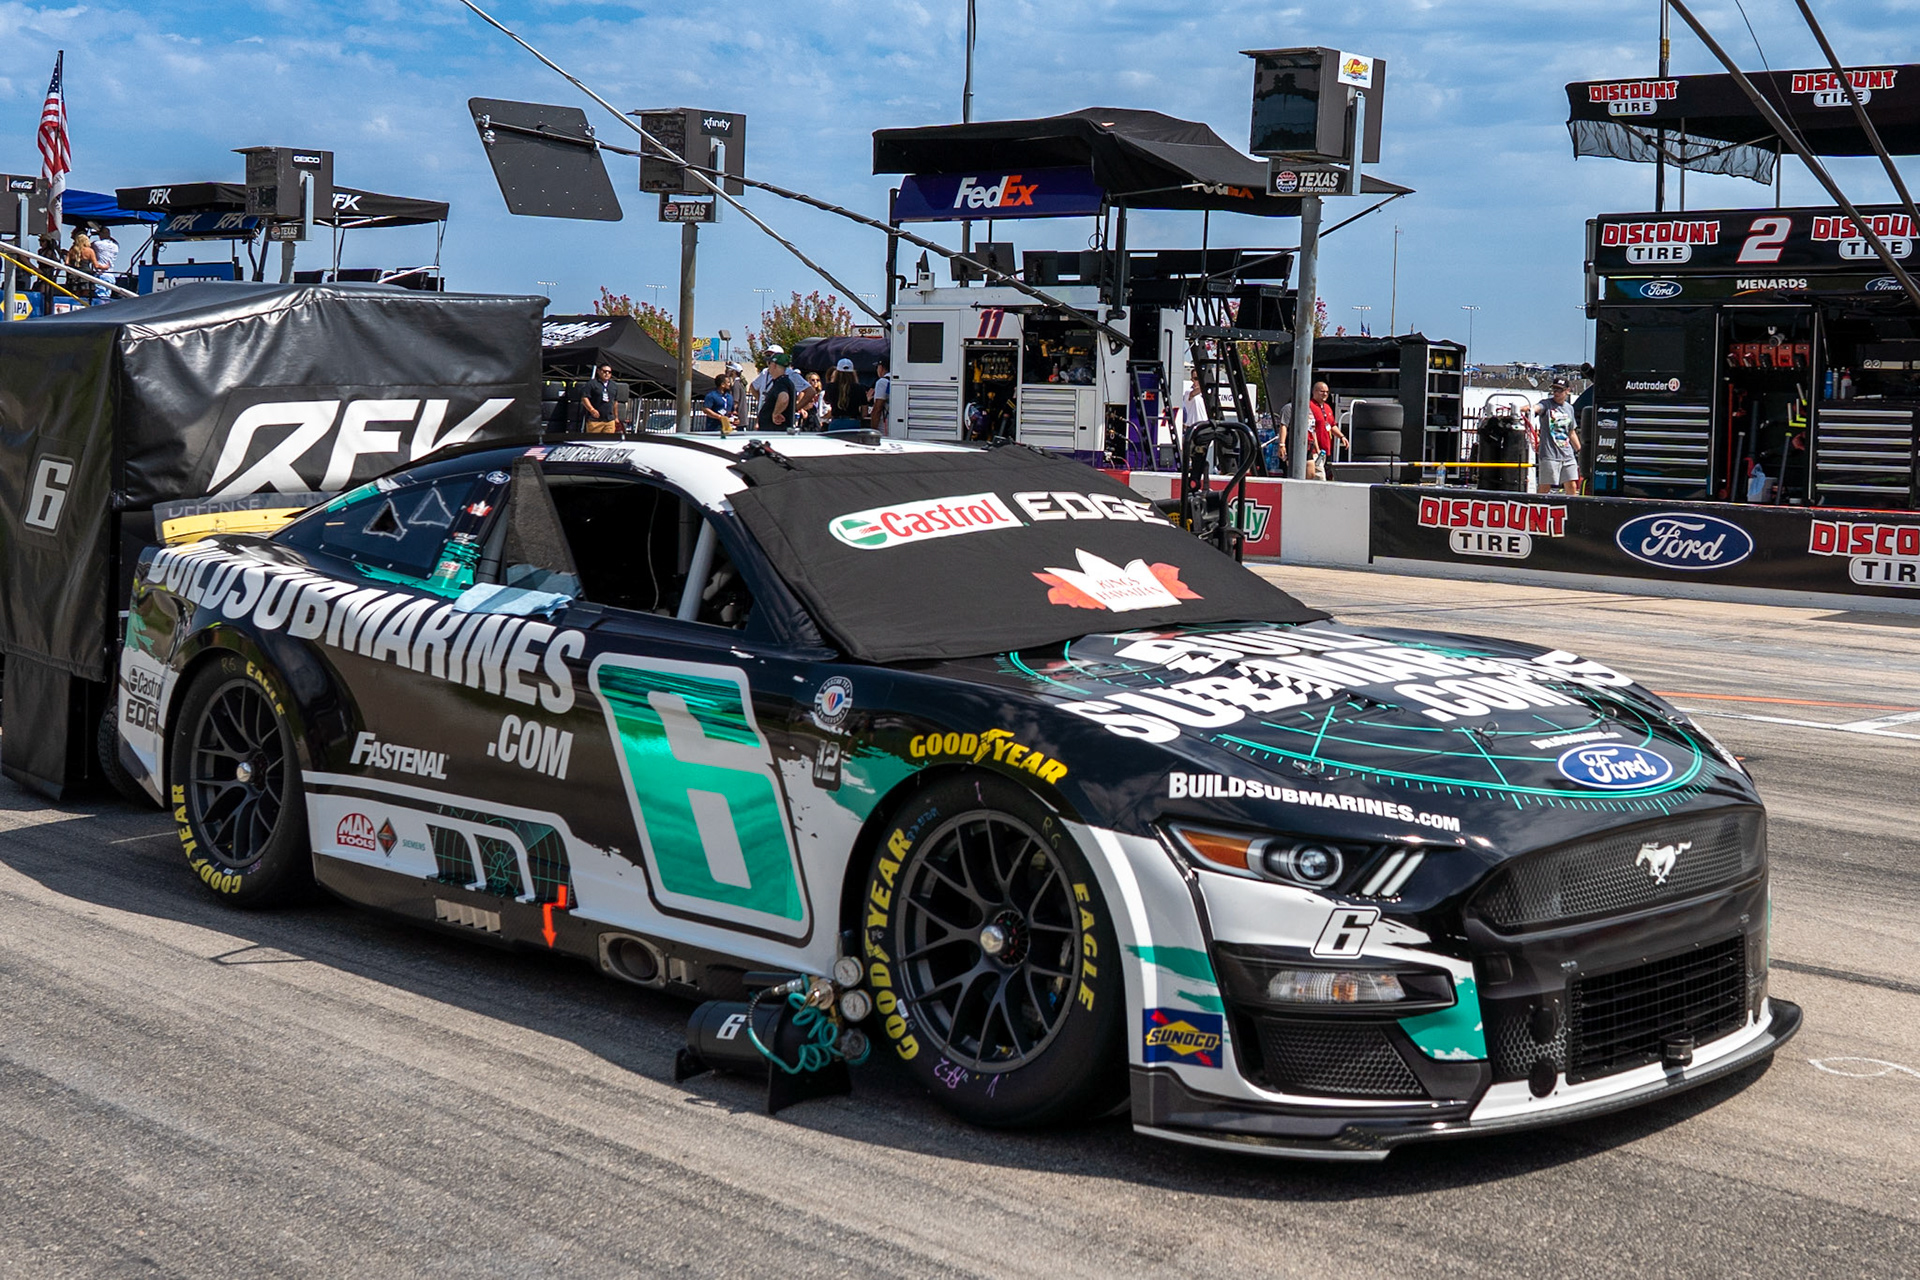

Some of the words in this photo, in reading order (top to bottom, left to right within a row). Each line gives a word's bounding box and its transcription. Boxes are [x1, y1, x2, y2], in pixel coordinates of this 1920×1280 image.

[1589, 81, 1680, 103] DISCOUNT
[1614, 102, 1651, 113] TIRE
[703, 117, 731, 131] xfinity
[953, 175, 1039, 209] FedEx
[1300, 172, 1339, 187] TEXAS
[148, 188, 172, 205] RFK
[680, 204, 706, 217] TEXAS
[1602, 220, 1720, 247] DISCOUNT
[1736, 216, 1793, 264] 2
[1634, 247, 1684, 260] TIRE
[1847, 241, 1903, 256] TIE
[1647, 283, 1675, 296] Ford
[1736, 279, 1808, 290] MENARDS
[977, 308, 1005, 340] 11
[1625, 380, 1668, 391] Autotrader
[24, 459, 75, 531] 6
[881, 498, 1005, 538] Castrol
[1012, 491, 1176, 529] EDGE
[1417, 496, 1567, 538] DISCOUNT
[1458, 532, 1521, 553] TIRE
[1641, 518, 1726, 562] Ford
[137, 672, 163, 701] Castro
[126, 698, 160, 733] EDG
[349, 731, 449, 781] FASTENAL
[487, 713, 575, 780] .COM
[1580, 747, 1657, 784] Ford
[589, 652, 808, 942] 6
[1168, 771, 1461, 832] BUILDSUBMARINES.COM
[338, 814, 374, 840] MAC
[338, 834, 375, 849] TOOLS
[1073, 882, 1099, 1012] EAGLE
[1309, 906, 1382, 960] 6
[716, 1013, 748, 1041] 6
[1146, 1027, 1221, 1051] SUNOCO
